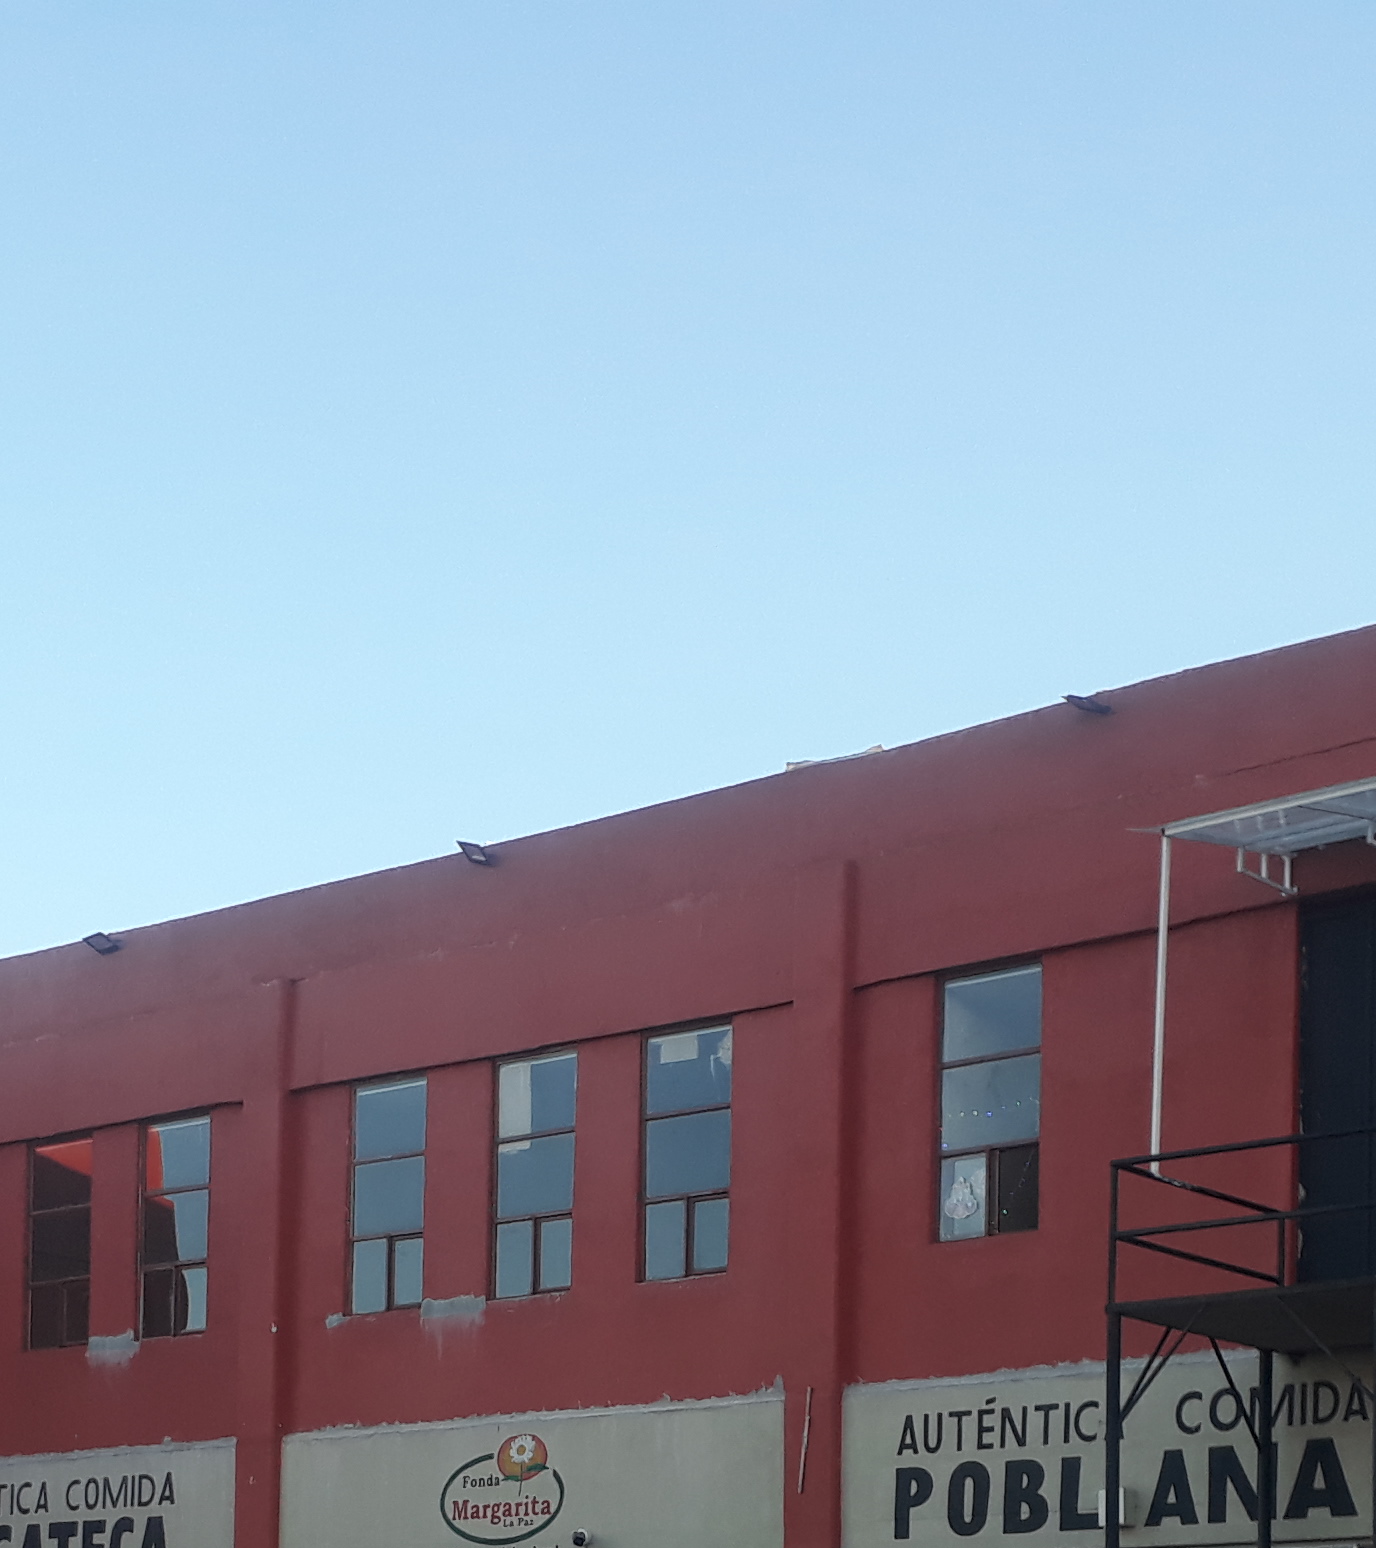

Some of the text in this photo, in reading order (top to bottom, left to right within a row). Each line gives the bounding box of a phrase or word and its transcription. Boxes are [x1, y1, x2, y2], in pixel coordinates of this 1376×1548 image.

[897, 1377, 1369, 1456] AUTÉNTIC COMIDA
[66, 1472, 175, 1511] COMIDA
[462, 1474, 500, 1489] Fonda
[894, 1437, 1358, 1539] POBLANA
[452, 1494, 552, 1525] Margarita
[503, 1517, 534, 1527] La Paz
